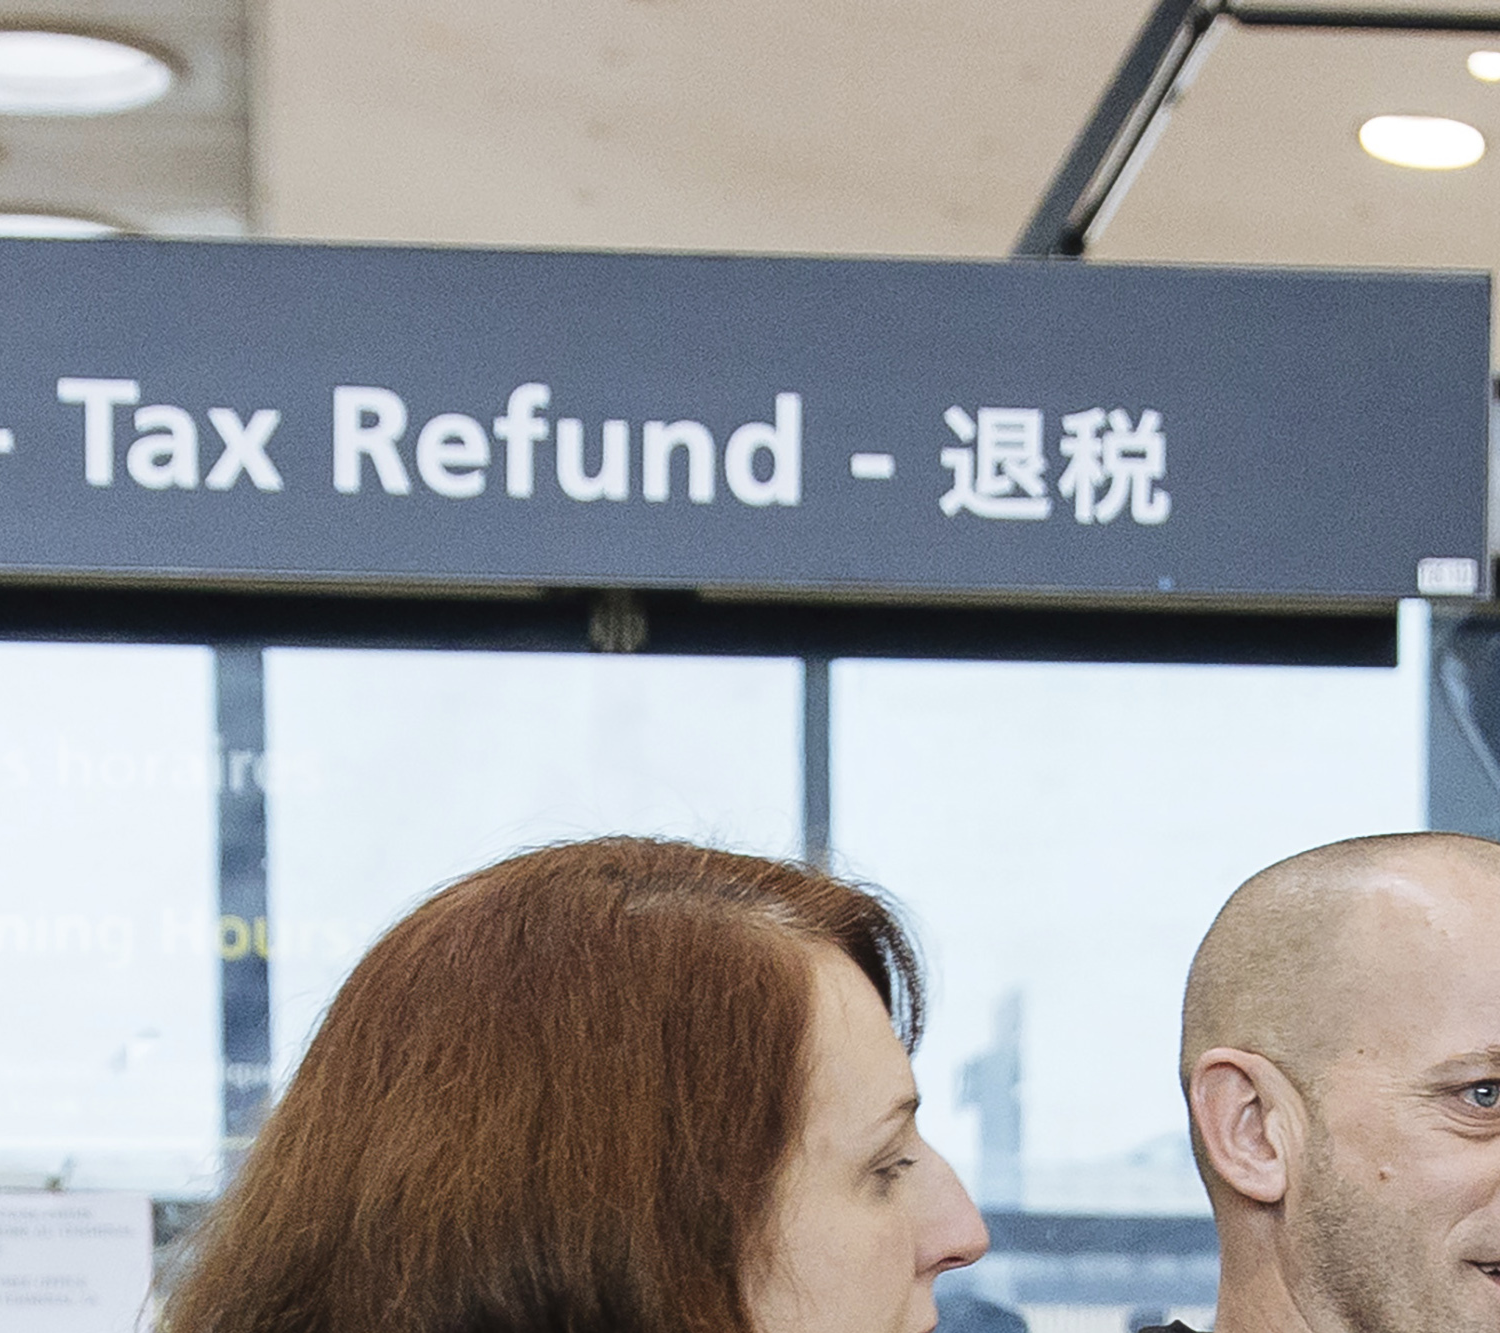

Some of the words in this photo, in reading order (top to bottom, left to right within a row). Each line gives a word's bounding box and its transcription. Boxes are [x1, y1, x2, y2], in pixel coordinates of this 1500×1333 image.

[56, 376, 283, 492] Tax
[333, 381, 803, 508] Refund
[851, 453, 896, 481] -
[939, 404, 1173, 526] 退税
